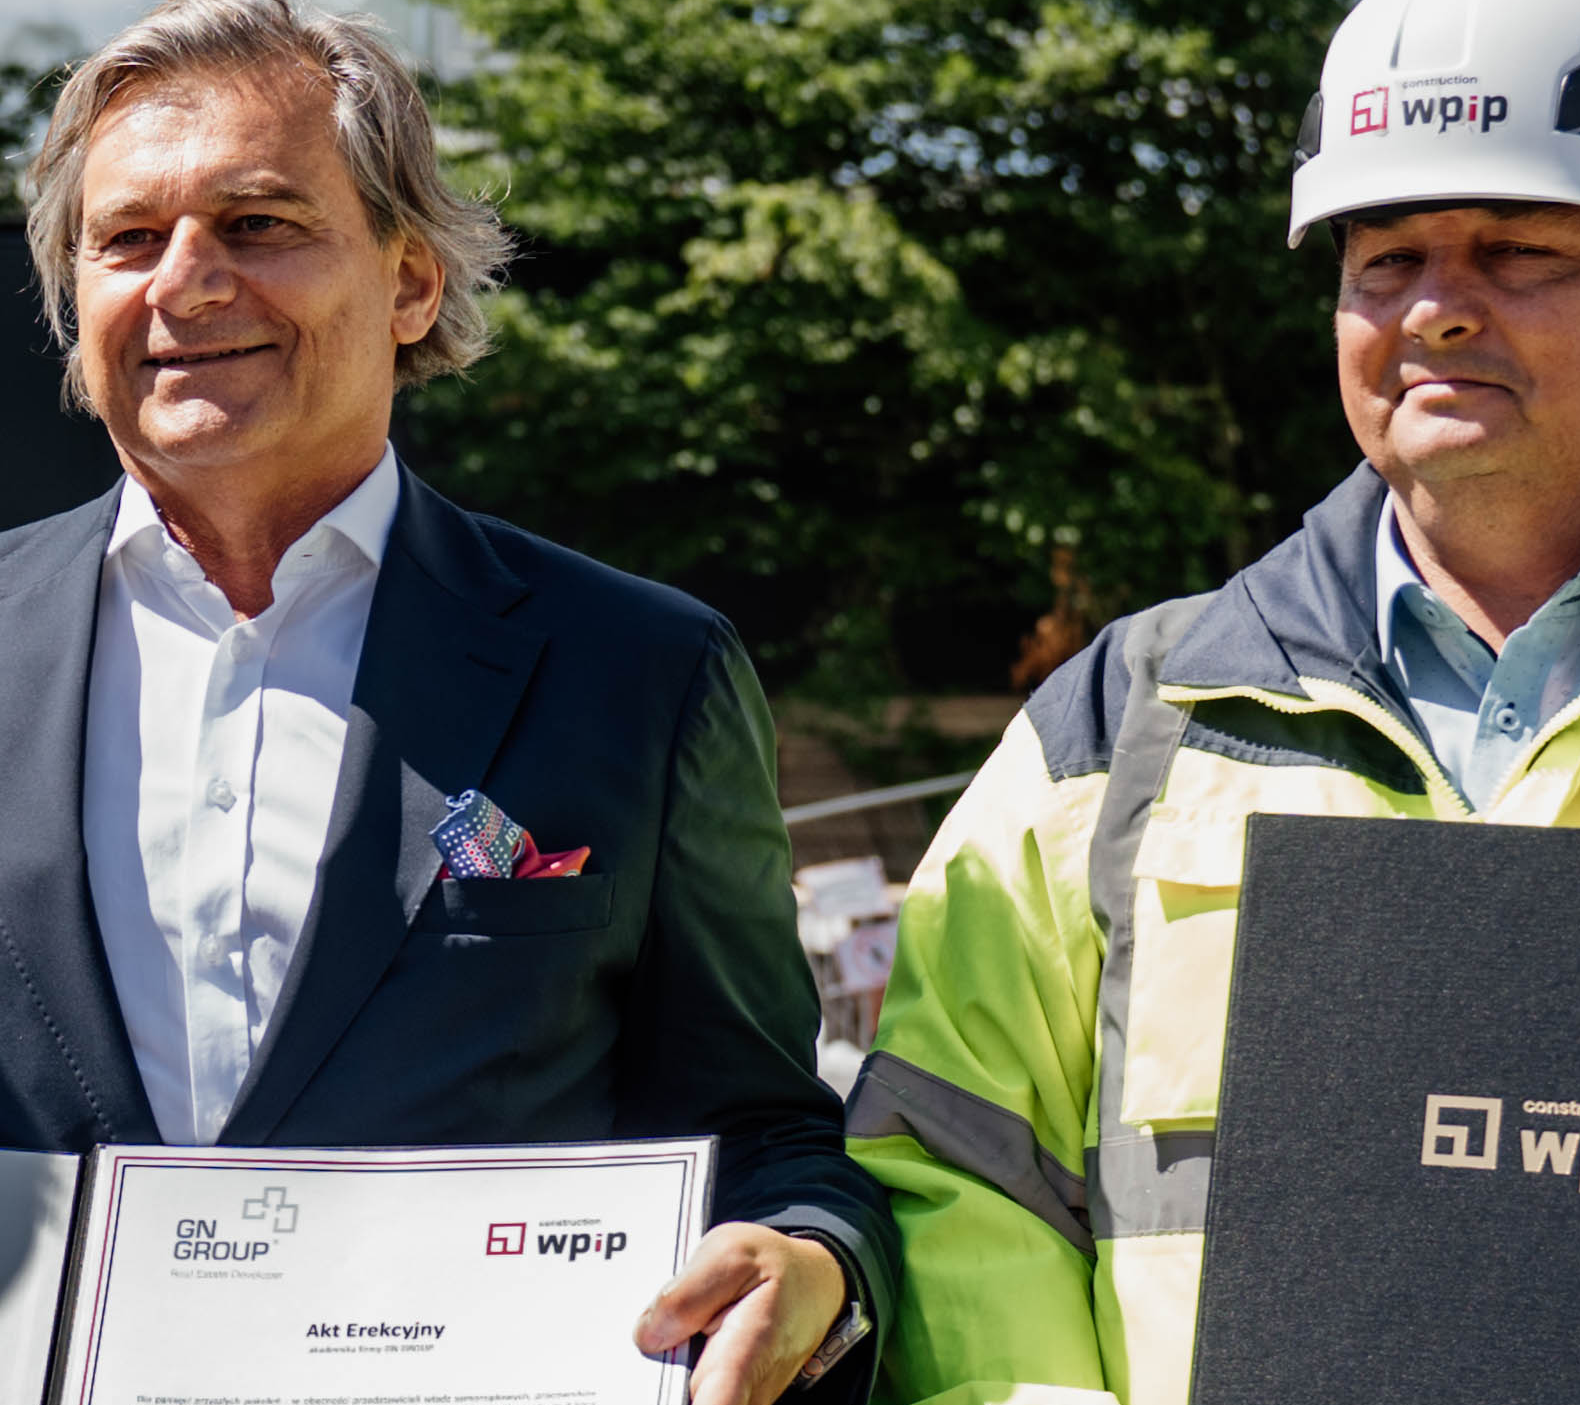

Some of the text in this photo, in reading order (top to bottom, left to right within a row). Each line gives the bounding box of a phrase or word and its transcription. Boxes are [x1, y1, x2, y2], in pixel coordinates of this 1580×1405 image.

[1402, 75, 1478, 89] construction
[1402, 95, 1508, 134] wpip
[176, 1219, 217, 1239] GN
[538, 1218, 602, 1228] construction
[173, 1240, 270, 1261] GROUP
[537, 1231, 627, 1262] wpip
[306, 1321, 446, 1340] Akt Erekcyjny
